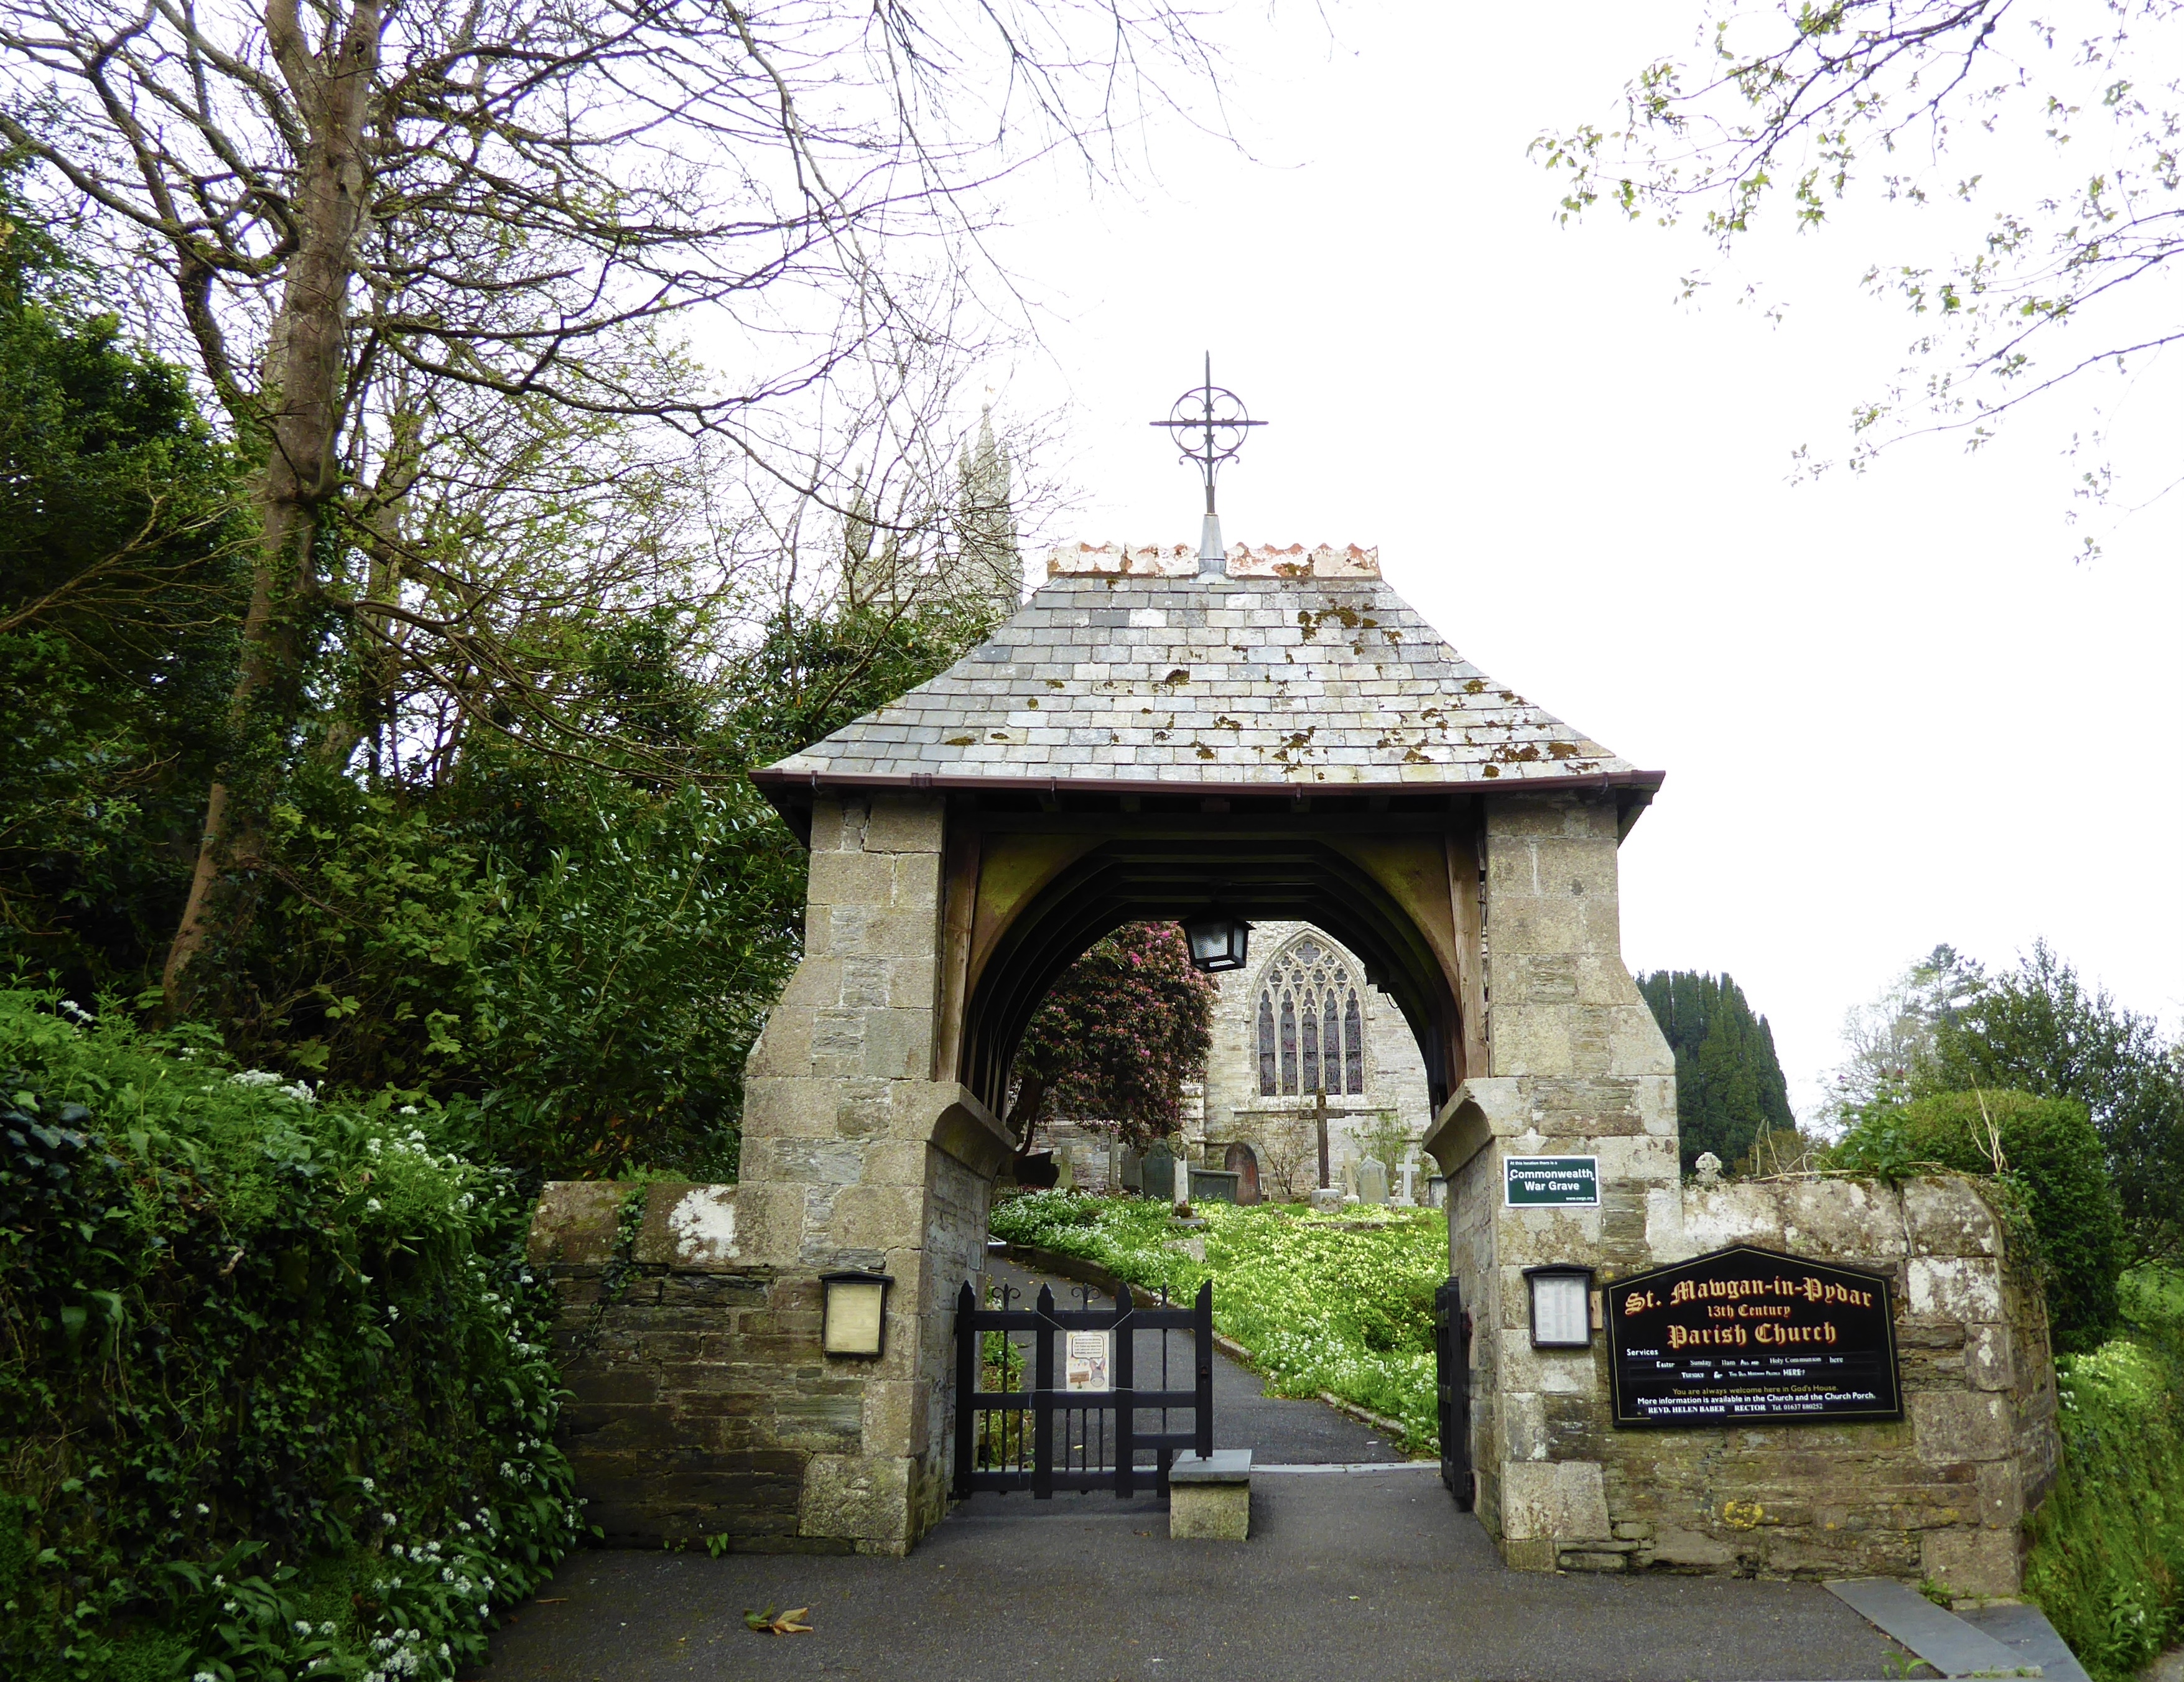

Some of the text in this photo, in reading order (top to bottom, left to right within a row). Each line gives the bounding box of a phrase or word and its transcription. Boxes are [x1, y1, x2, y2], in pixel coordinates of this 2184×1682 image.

[1510, 1169, 1593, 1179] Commonwealth
[1525, 1181, 1580, 1191] War Grave
[1625, 1276, 1872, 1315] St. Mawgan-in-Pydar
[1708, 1304, 1790, 1319] 13th Century
[1667, 1322, 1837, 1349] Parish Church
[1702, 1387, 1727, 1396] always
[1711, 1395, 1742, 1403] available
